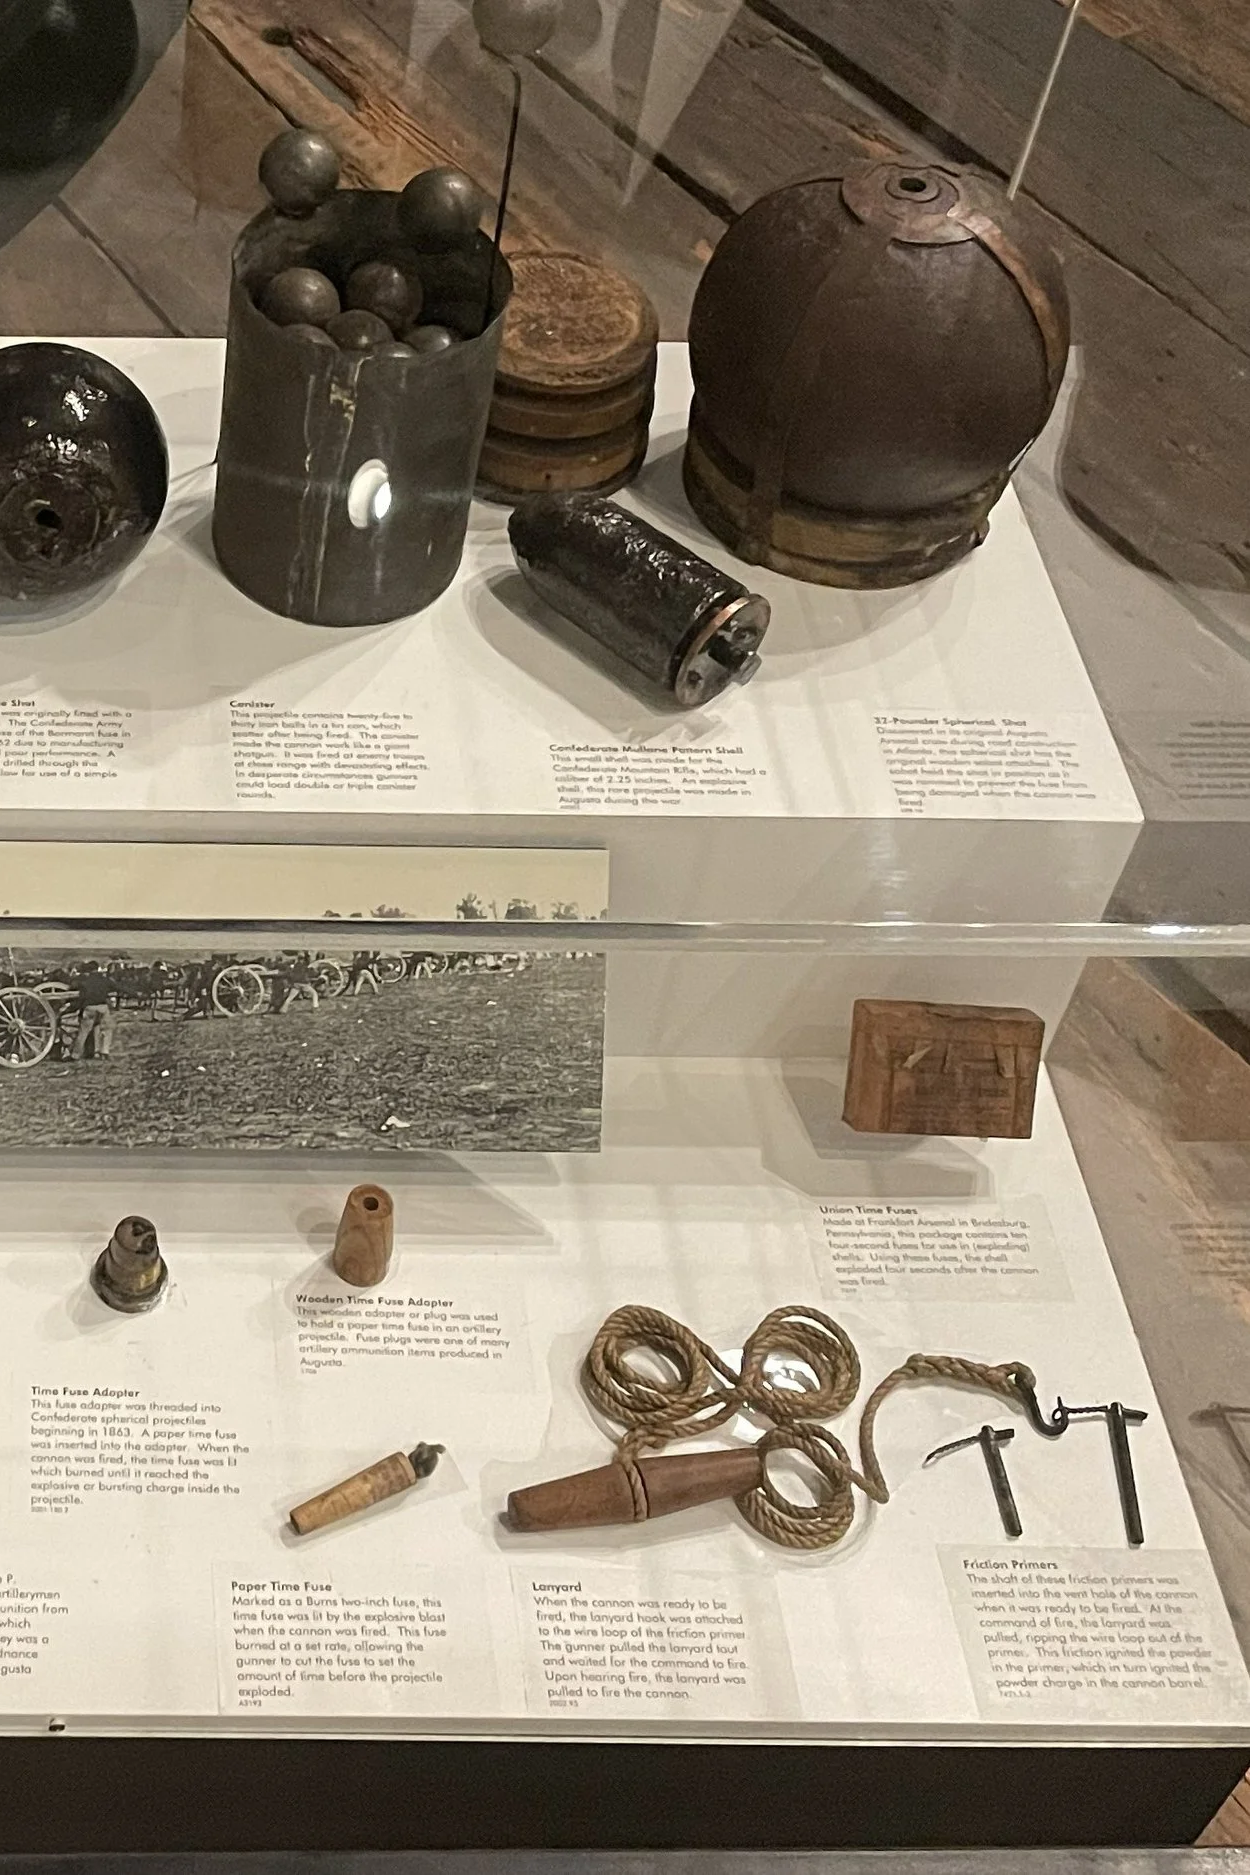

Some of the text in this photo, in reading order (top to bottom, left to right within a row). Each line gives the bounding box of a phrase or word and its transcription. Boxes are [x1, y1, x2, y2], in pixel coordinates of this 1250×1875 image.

[296, 1294, 453, 1308] Wooden Time Fuse Adapter
[31, 1385, 139, 1399] Time Fuse Adapter
[30, 1412, 206, 1426] Confederate spherical projectiles
[30, 1425, 237, 1440] beginning in 1863. A paper time fuse
[963, 1559, 1058, 1569] Friction Primers
[231, 1581, 332, 1593] Paper Time Fuse
[532, 1582, 582, 1594] Lanyard
[232, 1596, 442, 1608] Marked as a Burns two-inch fuse, this
[533, 1597, 727, 1611] When the cannon was ready to be
[979, 1617, 1172, 1630] command of fire, the lanyard was
[233, 1626, 264, 1635] when
[267, 1626, 286, 1636] the
[288, 1627, 332, 1636] cannon
[334, 1628, 357, 1636] was
[398, 1626, 420, 1637] This
[423, 1626, 447, 1637] fuse
[238, 1687, 294, 1698] exploded.
